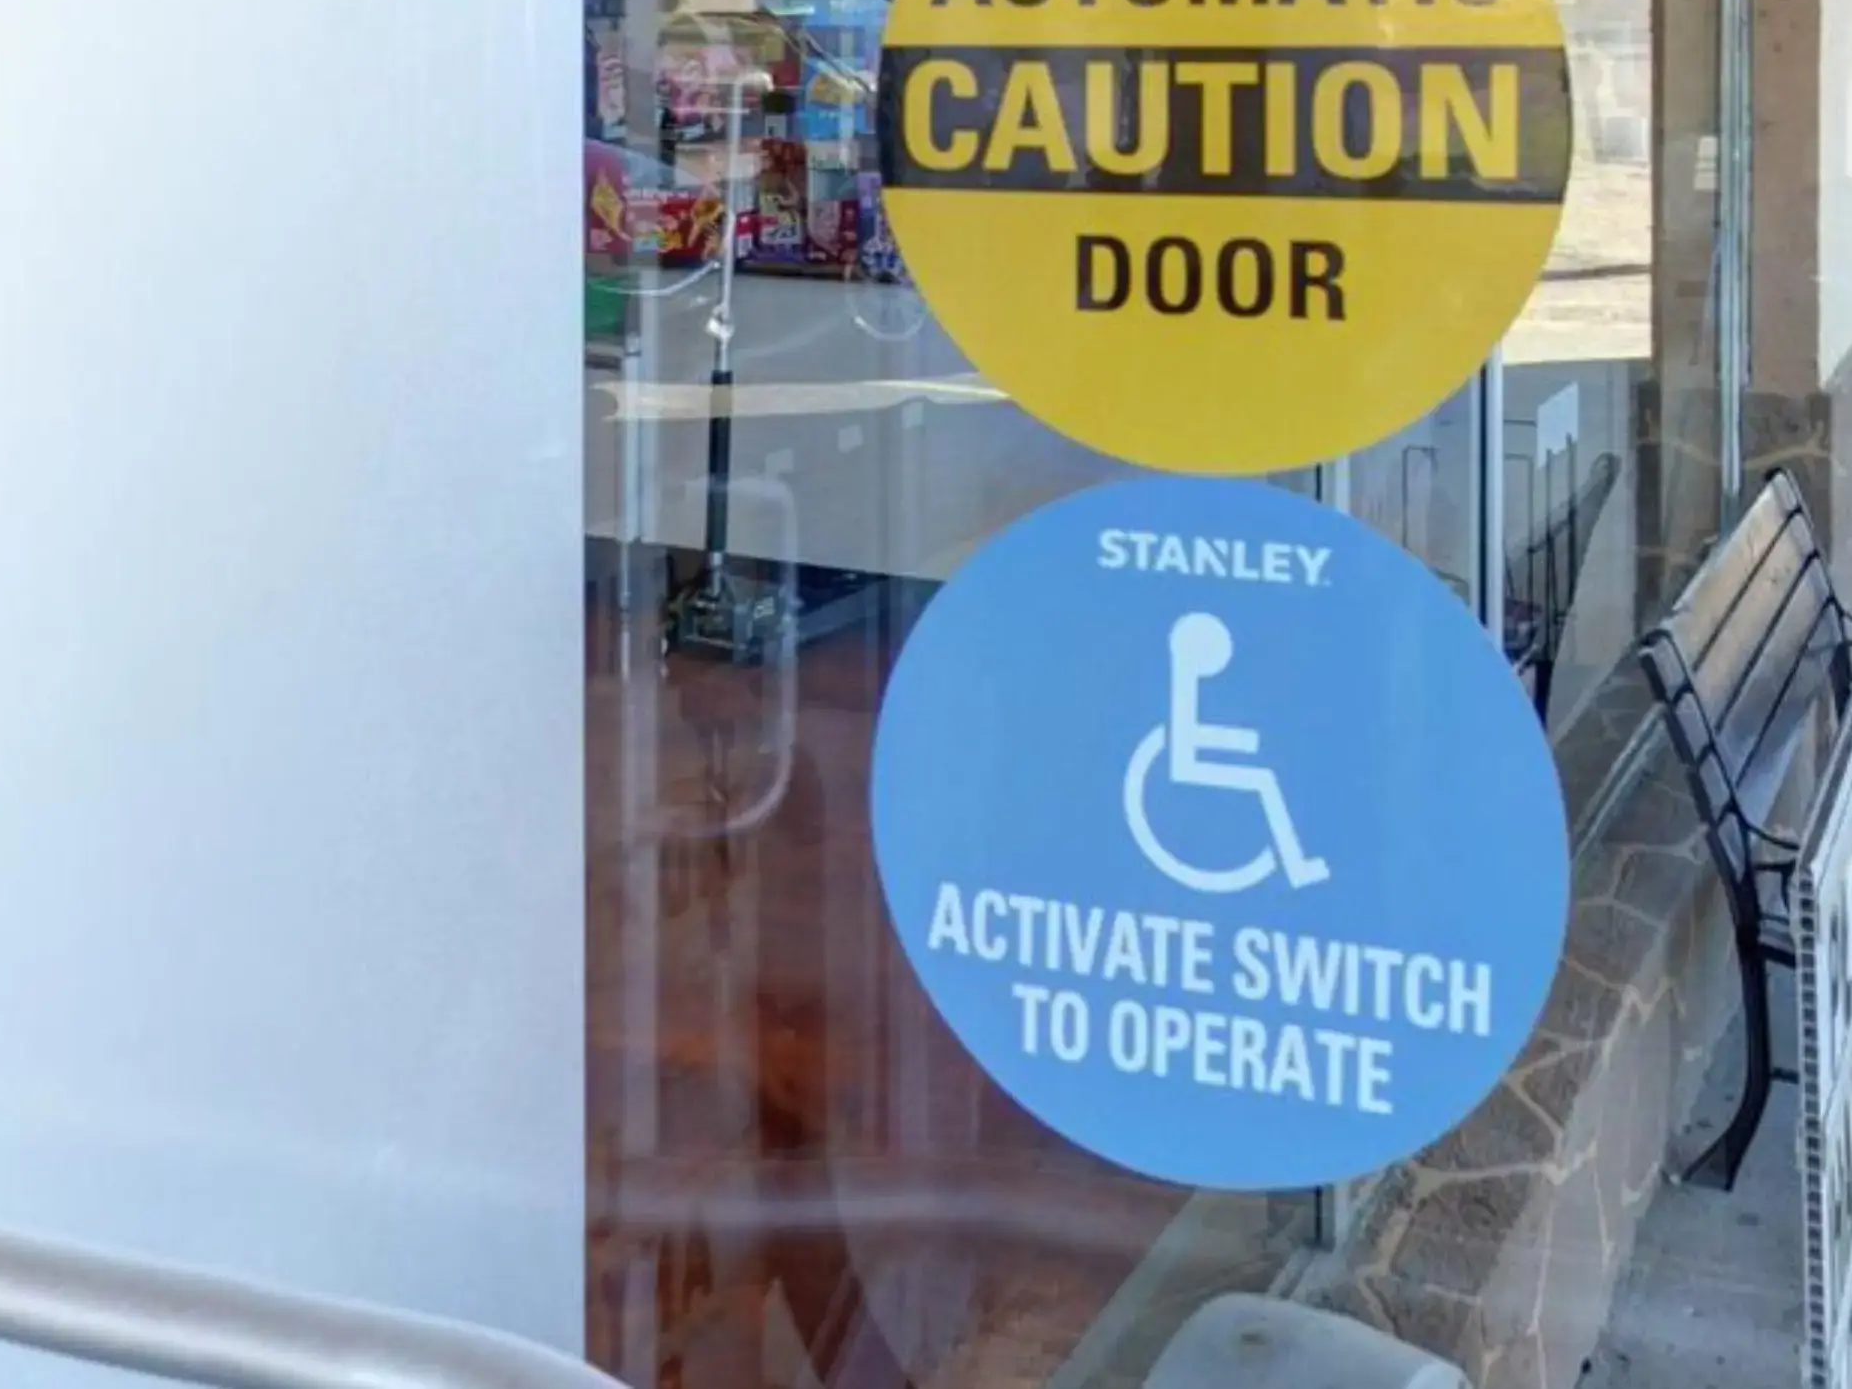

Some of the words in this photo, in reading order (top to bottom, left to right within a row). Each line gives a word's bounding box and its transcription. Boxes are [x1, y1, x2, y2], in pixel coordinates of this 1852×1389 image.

[902, 58, 1521, 182] CAUTION
[1074, 232, 1348, 322] DOOR
[1097, 528, 1332, 587] STANLEY
[927, 882, 1215, 995] ACTIVATE
[1233, 927, 1492, 1039] SWITCH
[1013, 984, 1089, 1063] TO
[1109, 1000, 1394, 1115] OPERATE
